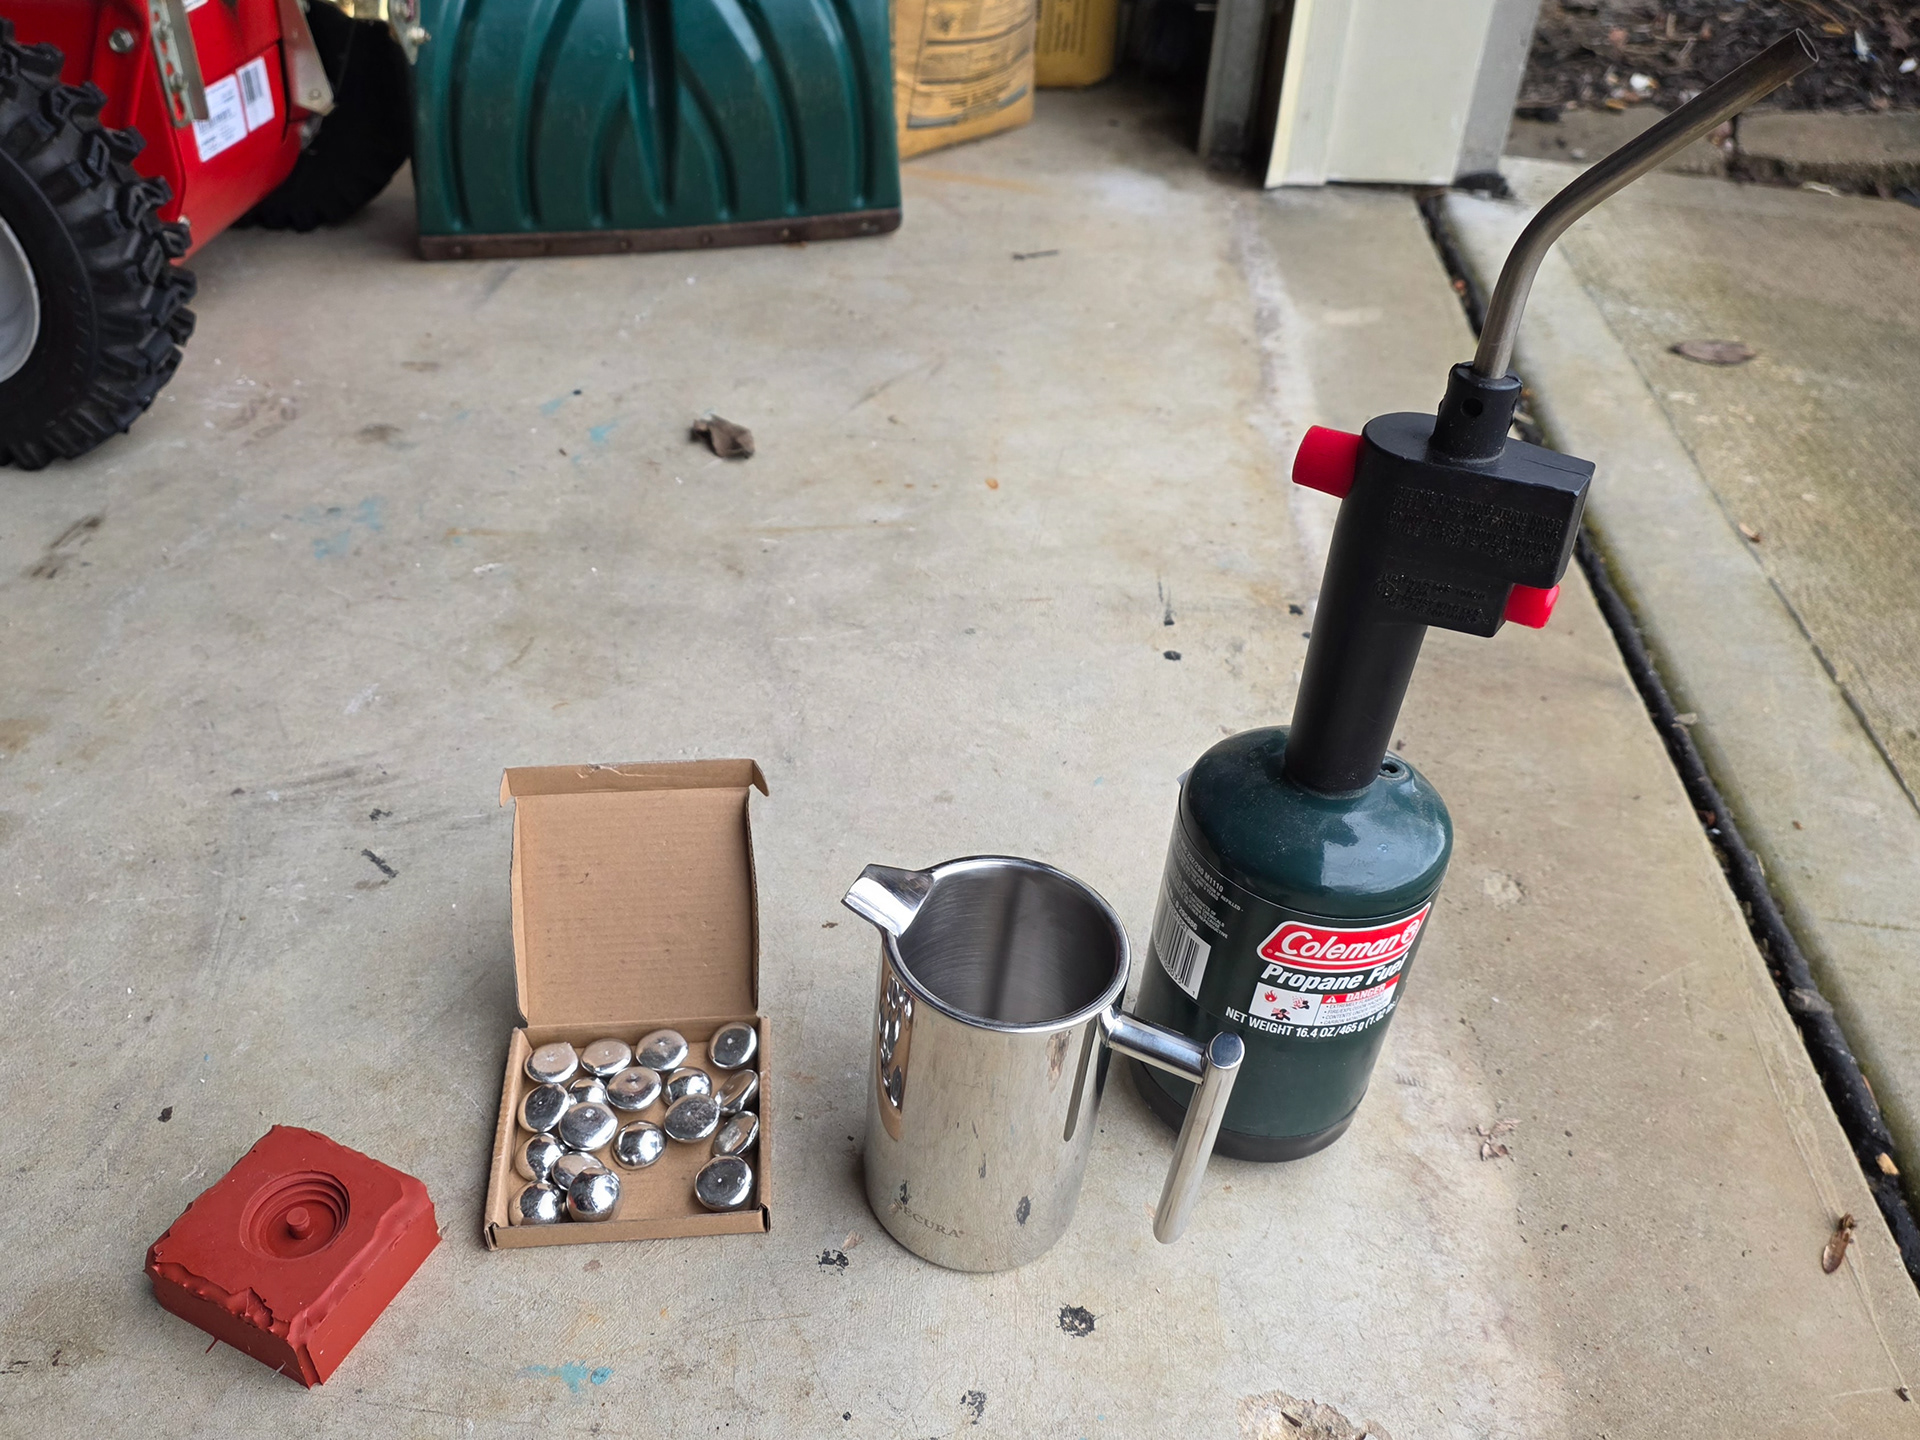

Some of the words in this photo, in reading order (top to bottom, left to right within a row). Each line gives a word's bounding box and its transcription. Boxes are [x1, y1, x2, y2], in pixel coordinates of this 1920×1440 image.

[1281, 931, 1401, 959] Coleman
[1260, 963, 1365, 992] Propane
[1365, 952, 1409, 985] Fuel
[1345, 983, 1387, 1002] DANGER
[1225, 1006, 1248, 1024] NET
[1249, 1016, 1296, 1036] WEIGHT
[1295, 1027, 1318, 1038] 16.4
